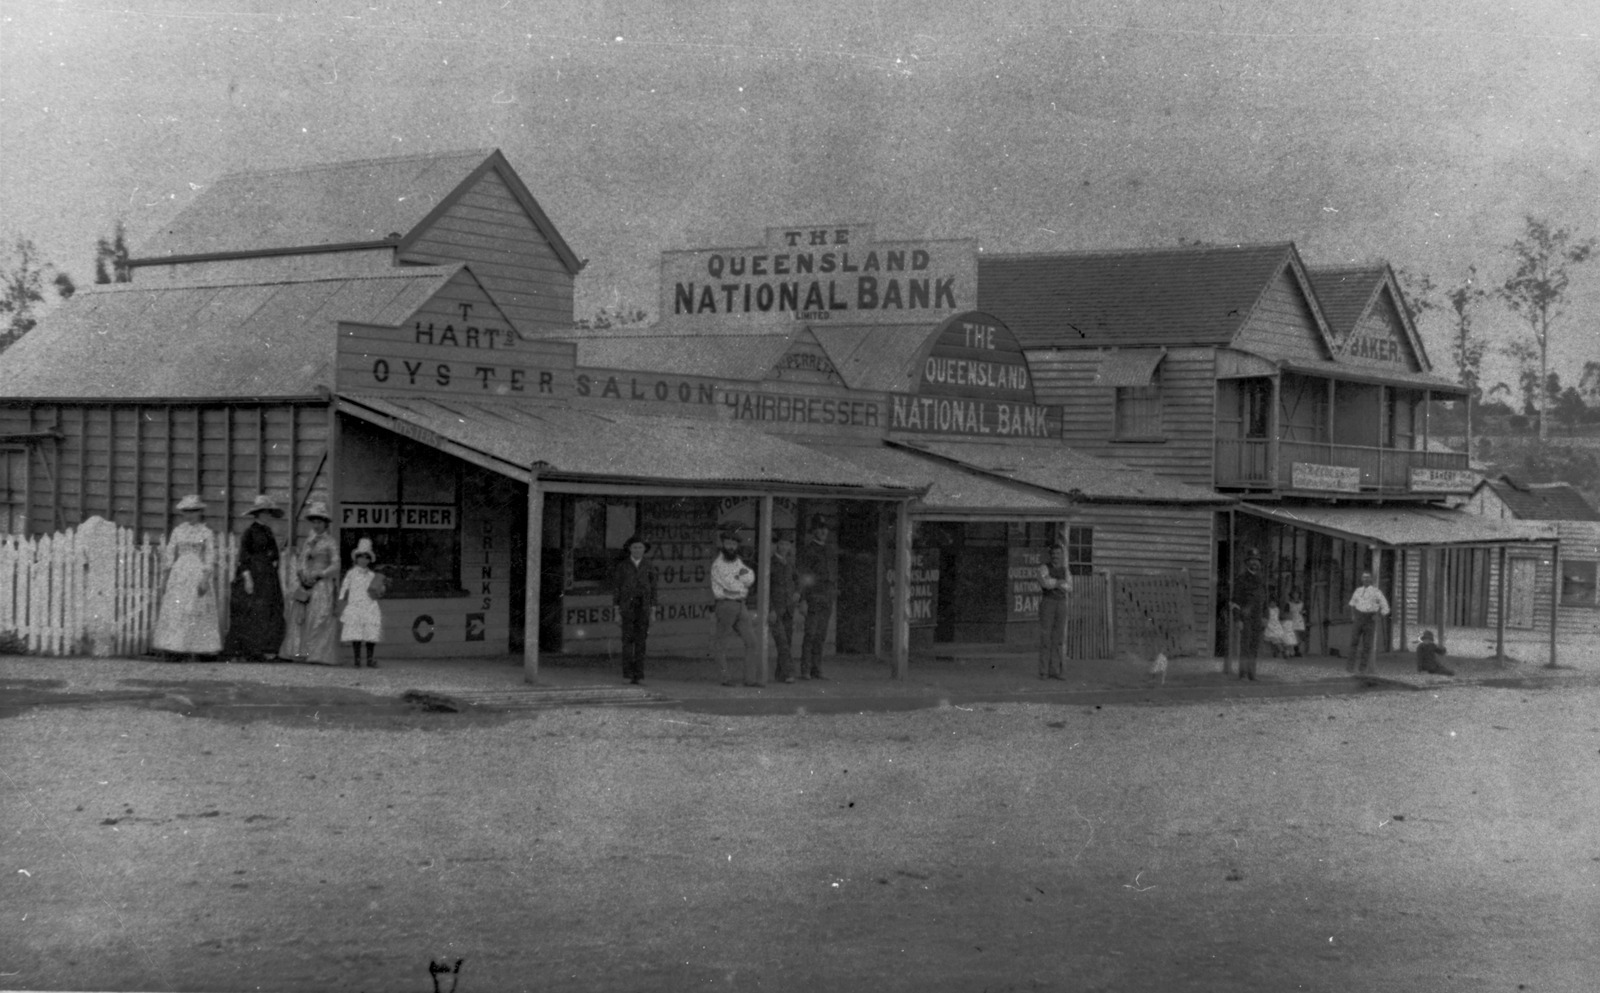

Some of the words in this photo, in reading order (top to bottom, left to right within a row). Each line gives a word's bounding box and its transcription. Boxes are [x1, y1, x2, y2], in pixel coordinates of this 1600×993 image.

[785, 229, 849, 247] THE
[708, 249, 930, 279] QUEENSLAND
[674, 280, 847, 315] NATIONAL
[857, 275, 957, 310] BANK
[459, 303, 473, 322] T
[962, 323, 996, 350] THE
[925, 357, 1028, 390] QUEENSLAND
[373, 359, 553, 394] OYSTER
[576, 374, 714, 405] SALOON
[724, 393, 879, 427] HAIRDRESSER
[891, 395, 991, 433] NATIONAL
[996, 404, 1049, 437] BANK
[343, 508, 452, 525] FRUITERER
[651, 542, 703, 561] AND
[1022, 553, 1041, 564] THE
[481, 518, 494, 612] DRINKS
[566, 607, 615, 625] FRES
[668, 604, 710, 620] DAILY
[1014, 595, 1043, 612] BAN
